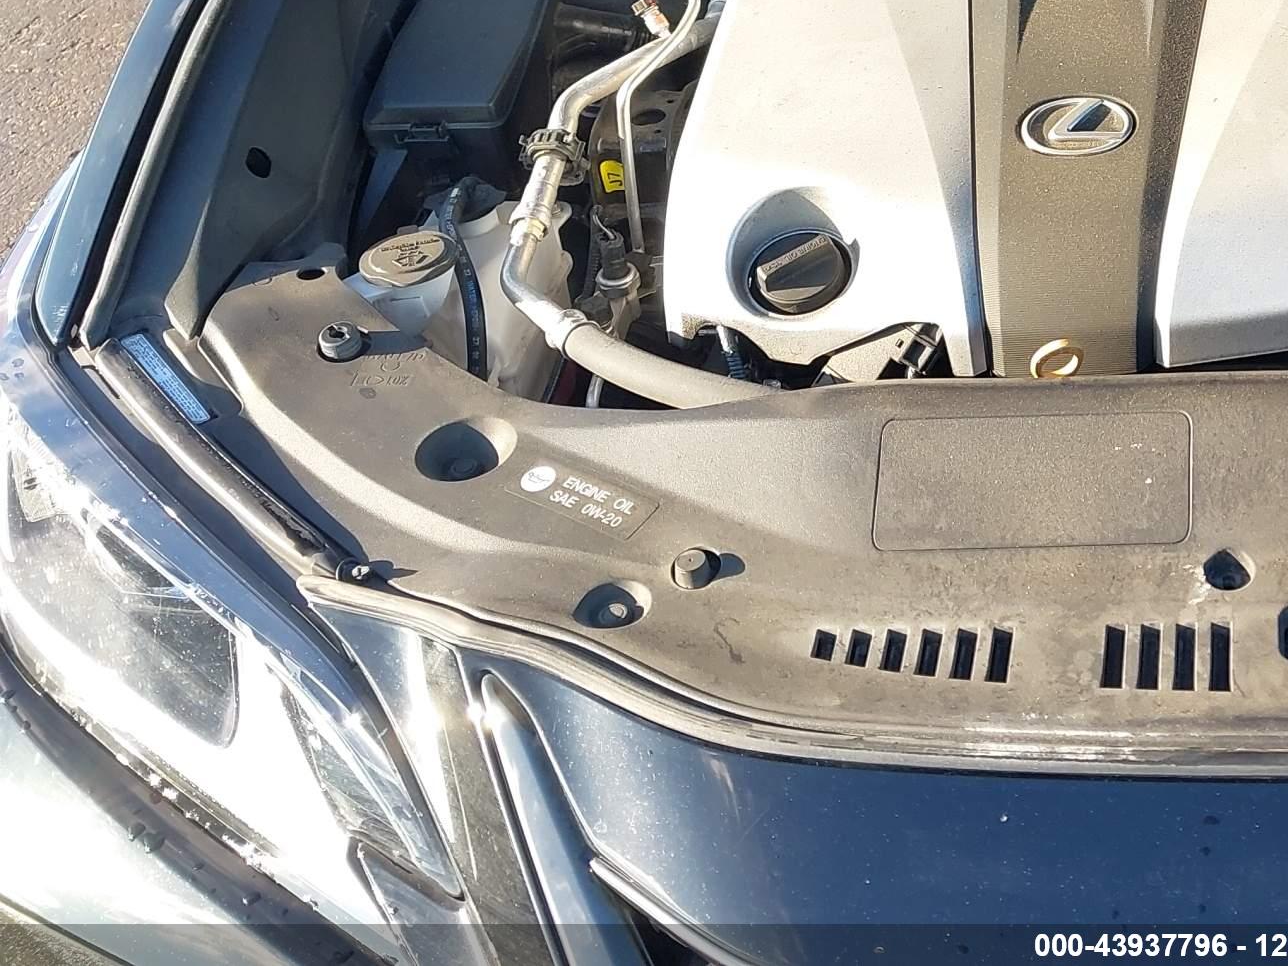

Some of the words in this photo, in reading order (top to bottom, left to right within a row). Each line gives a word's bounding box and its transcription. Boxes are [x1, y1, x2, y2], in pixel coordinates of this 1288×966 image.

[549, 490, 580, 509] SAE
[581, 503, 623, 528] 0W-20
[562, 476, 611, 503] ENGINE
[613, 498, 635, 515] OIL
